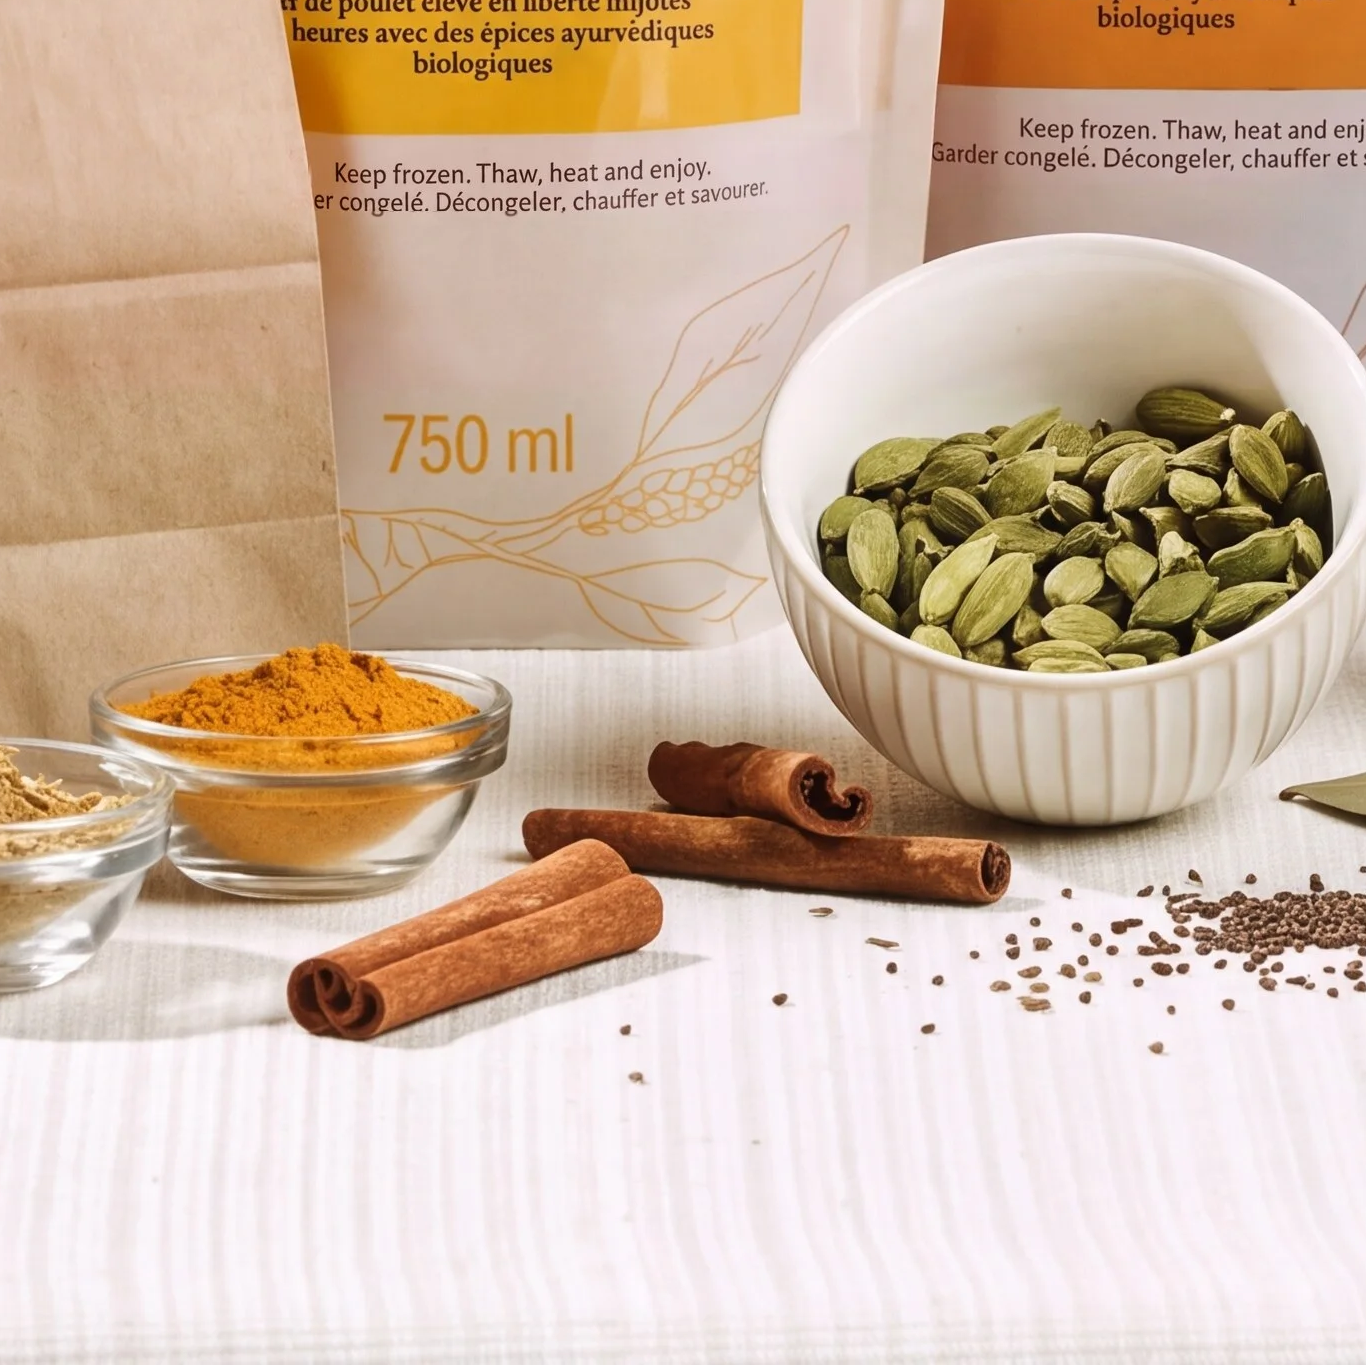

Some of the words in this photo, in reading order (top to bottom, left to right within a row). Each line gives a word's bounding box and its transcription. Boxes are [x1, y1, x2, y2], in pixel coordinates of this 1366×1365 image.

[291, 17, 369, 44] heures
[375, 27, 428, 44] avec
[433, 20, 474, 44] des
[480, 21, 555, 51] épices
[561, 19, 714, 51] ayurvédiques
[1097, 4, 1236, 36] biologiques
[412, 50, 553, 82] biologiques
[1020, 117, 1074, 144] Keep
[1080, 118, 1157, 140] frozen.
[1162, 119, 1227, 143] Thaw,
[1234, 119, 1283, 140] heat
[1287, 118, 1327, 140] and
[335, 162, 387, 190] Keep
[392, 162, 471, 185] frozen.
[475, 161, 543, 187] Thaw,
[550, 161, 599, 183] heat
[604, 159, 643, 182] and
[649, 157, 711, 183] enjoy.
[1004, 144, 1096, 173] congelé.
[1103, 147, 1235, 174] Décongeler,
[1241, 147, 1331, 169] chauffer
[1336, 149, 1358, 168] et
[436, 190, 566, 217] Décongeler,
[572, 187, 659, 211] chauffer
[664, 188, 686, 206] et
[690, 178, 771, 204] savourer.
[383, 413, 489, 475] 750
[508, 412, 574, 473] ml
